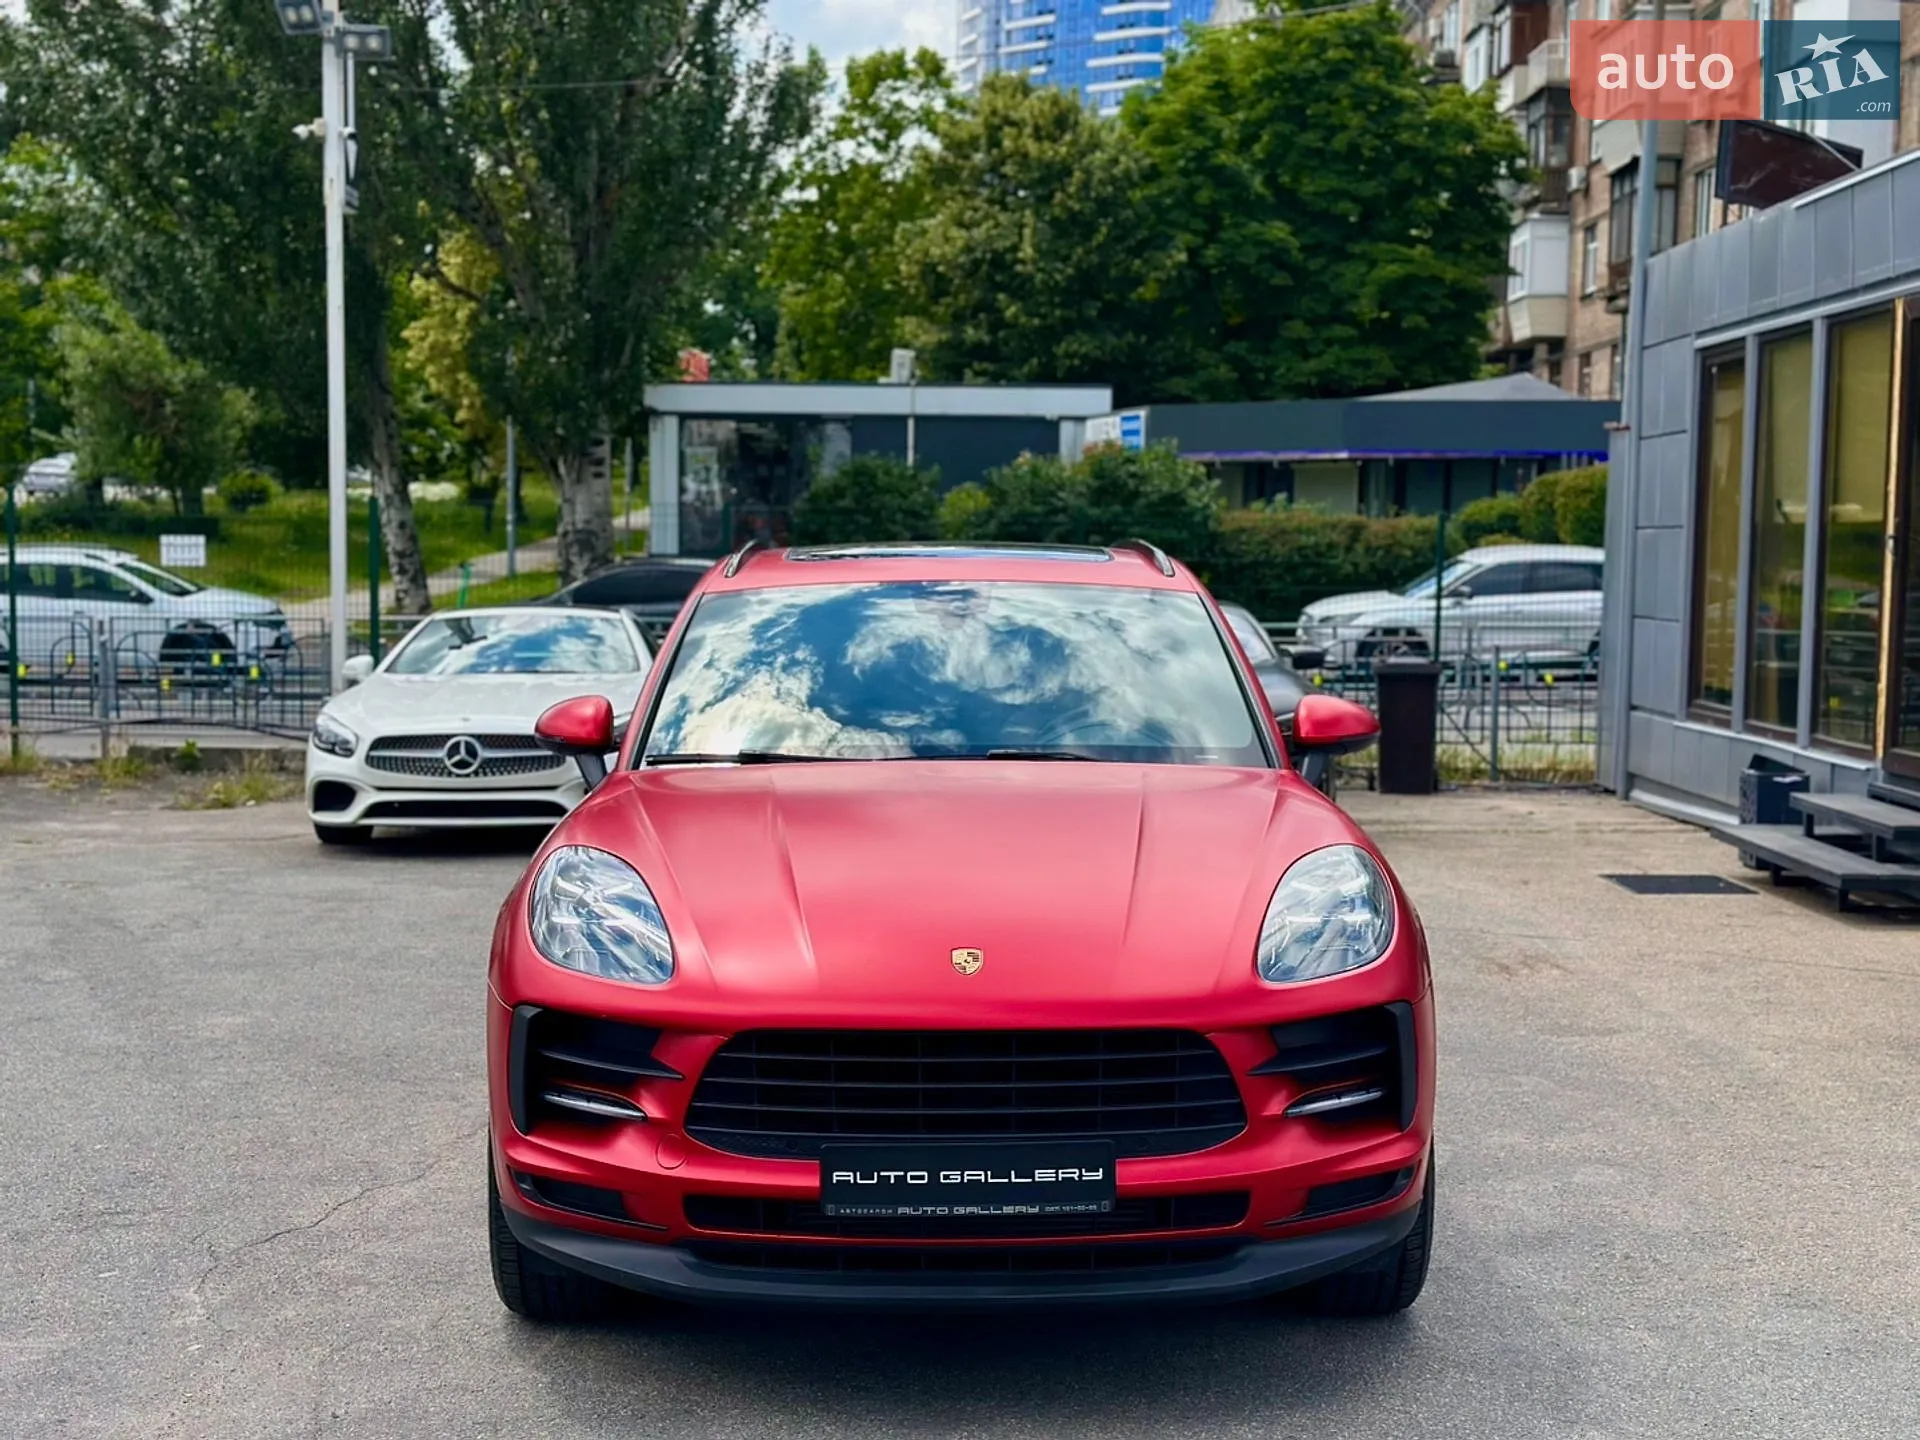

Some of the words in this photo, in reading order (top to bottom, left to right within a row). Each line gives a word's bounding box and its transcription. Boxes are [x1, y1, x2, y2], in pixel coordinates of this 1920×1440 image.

[831, 1170, 929, 1185] AUTO
[939, 1167, 1104, 1184] GALLERY
[897, 1205, 949, 1216] AUTO
[953, 1204, 1040, 1216] GALLERY
